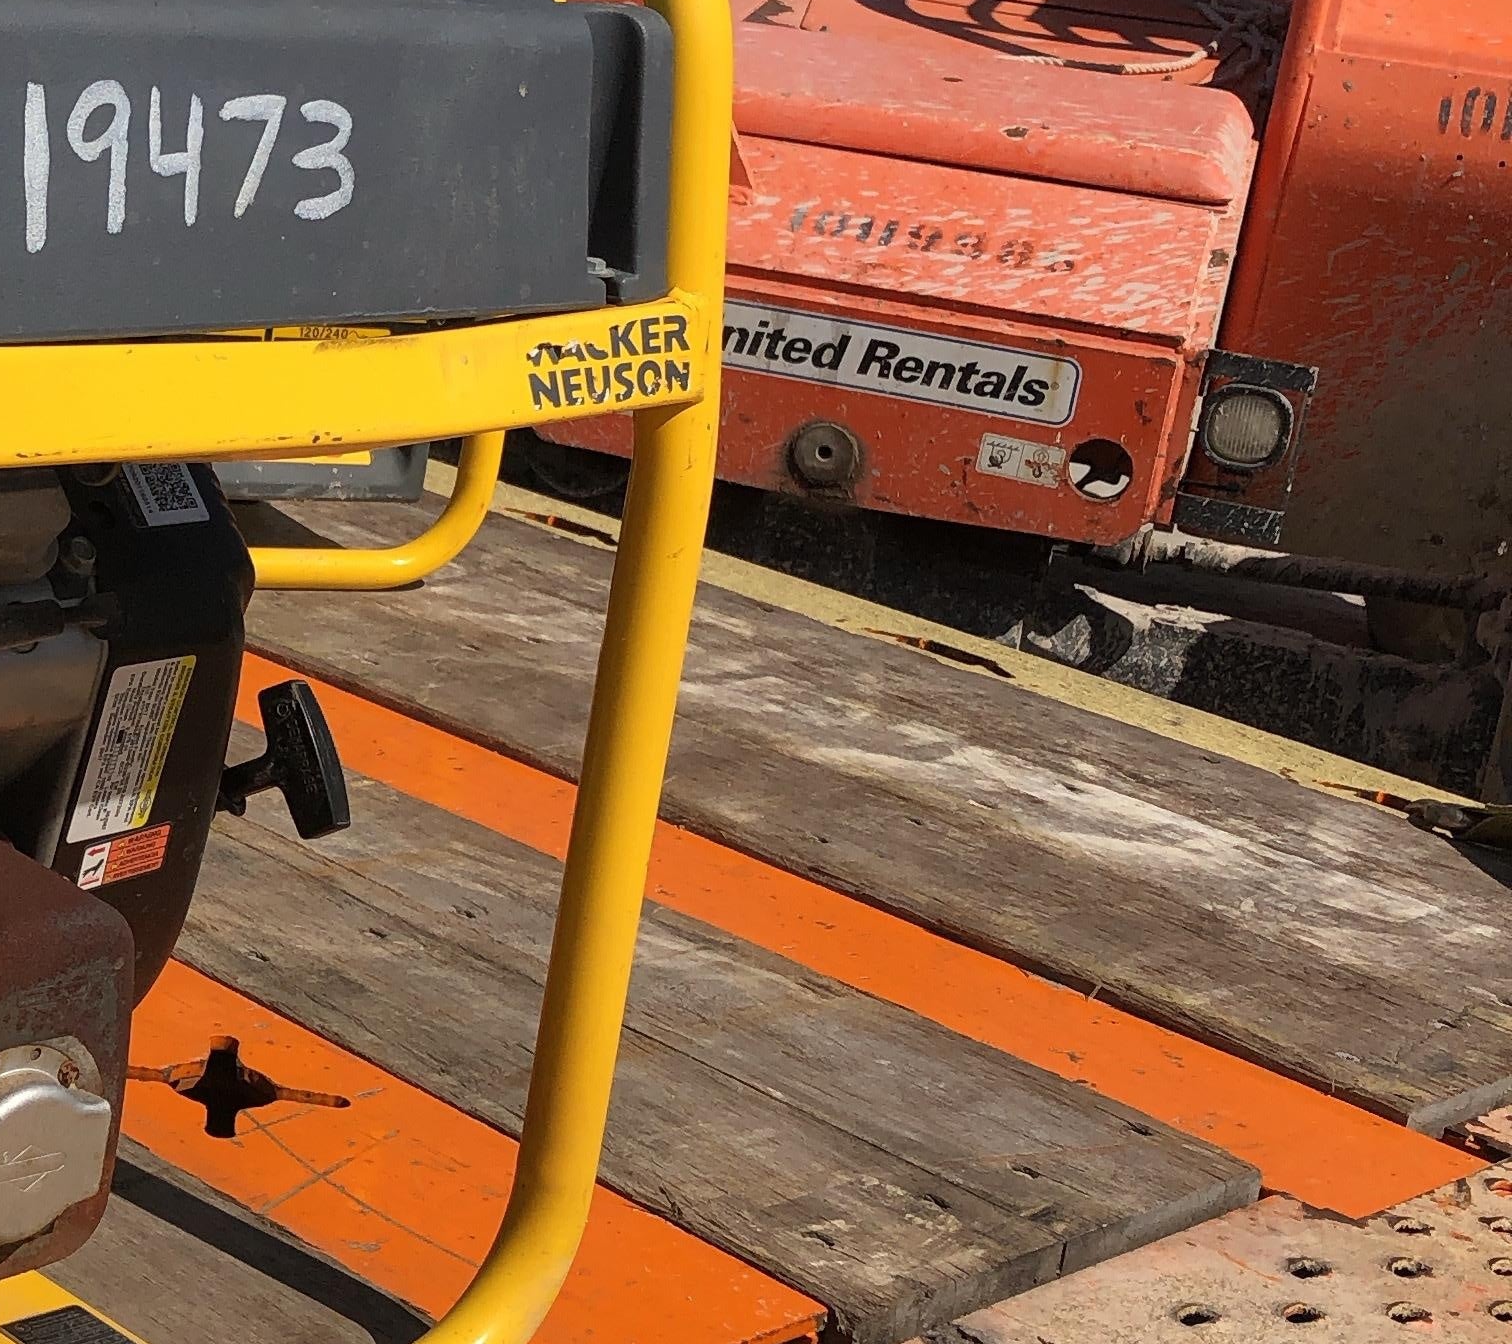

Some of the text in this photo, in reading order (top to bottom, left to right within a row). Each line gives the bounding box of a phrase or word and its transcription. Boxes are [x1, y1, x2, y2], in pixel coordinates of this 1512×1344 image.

[23, 78, 357, 255] 19473
[300, 327, 348, 340] 120/240
[721, 319, 1051, 409] nited Rentals
[528, 359, 691, 411] NEUSON
